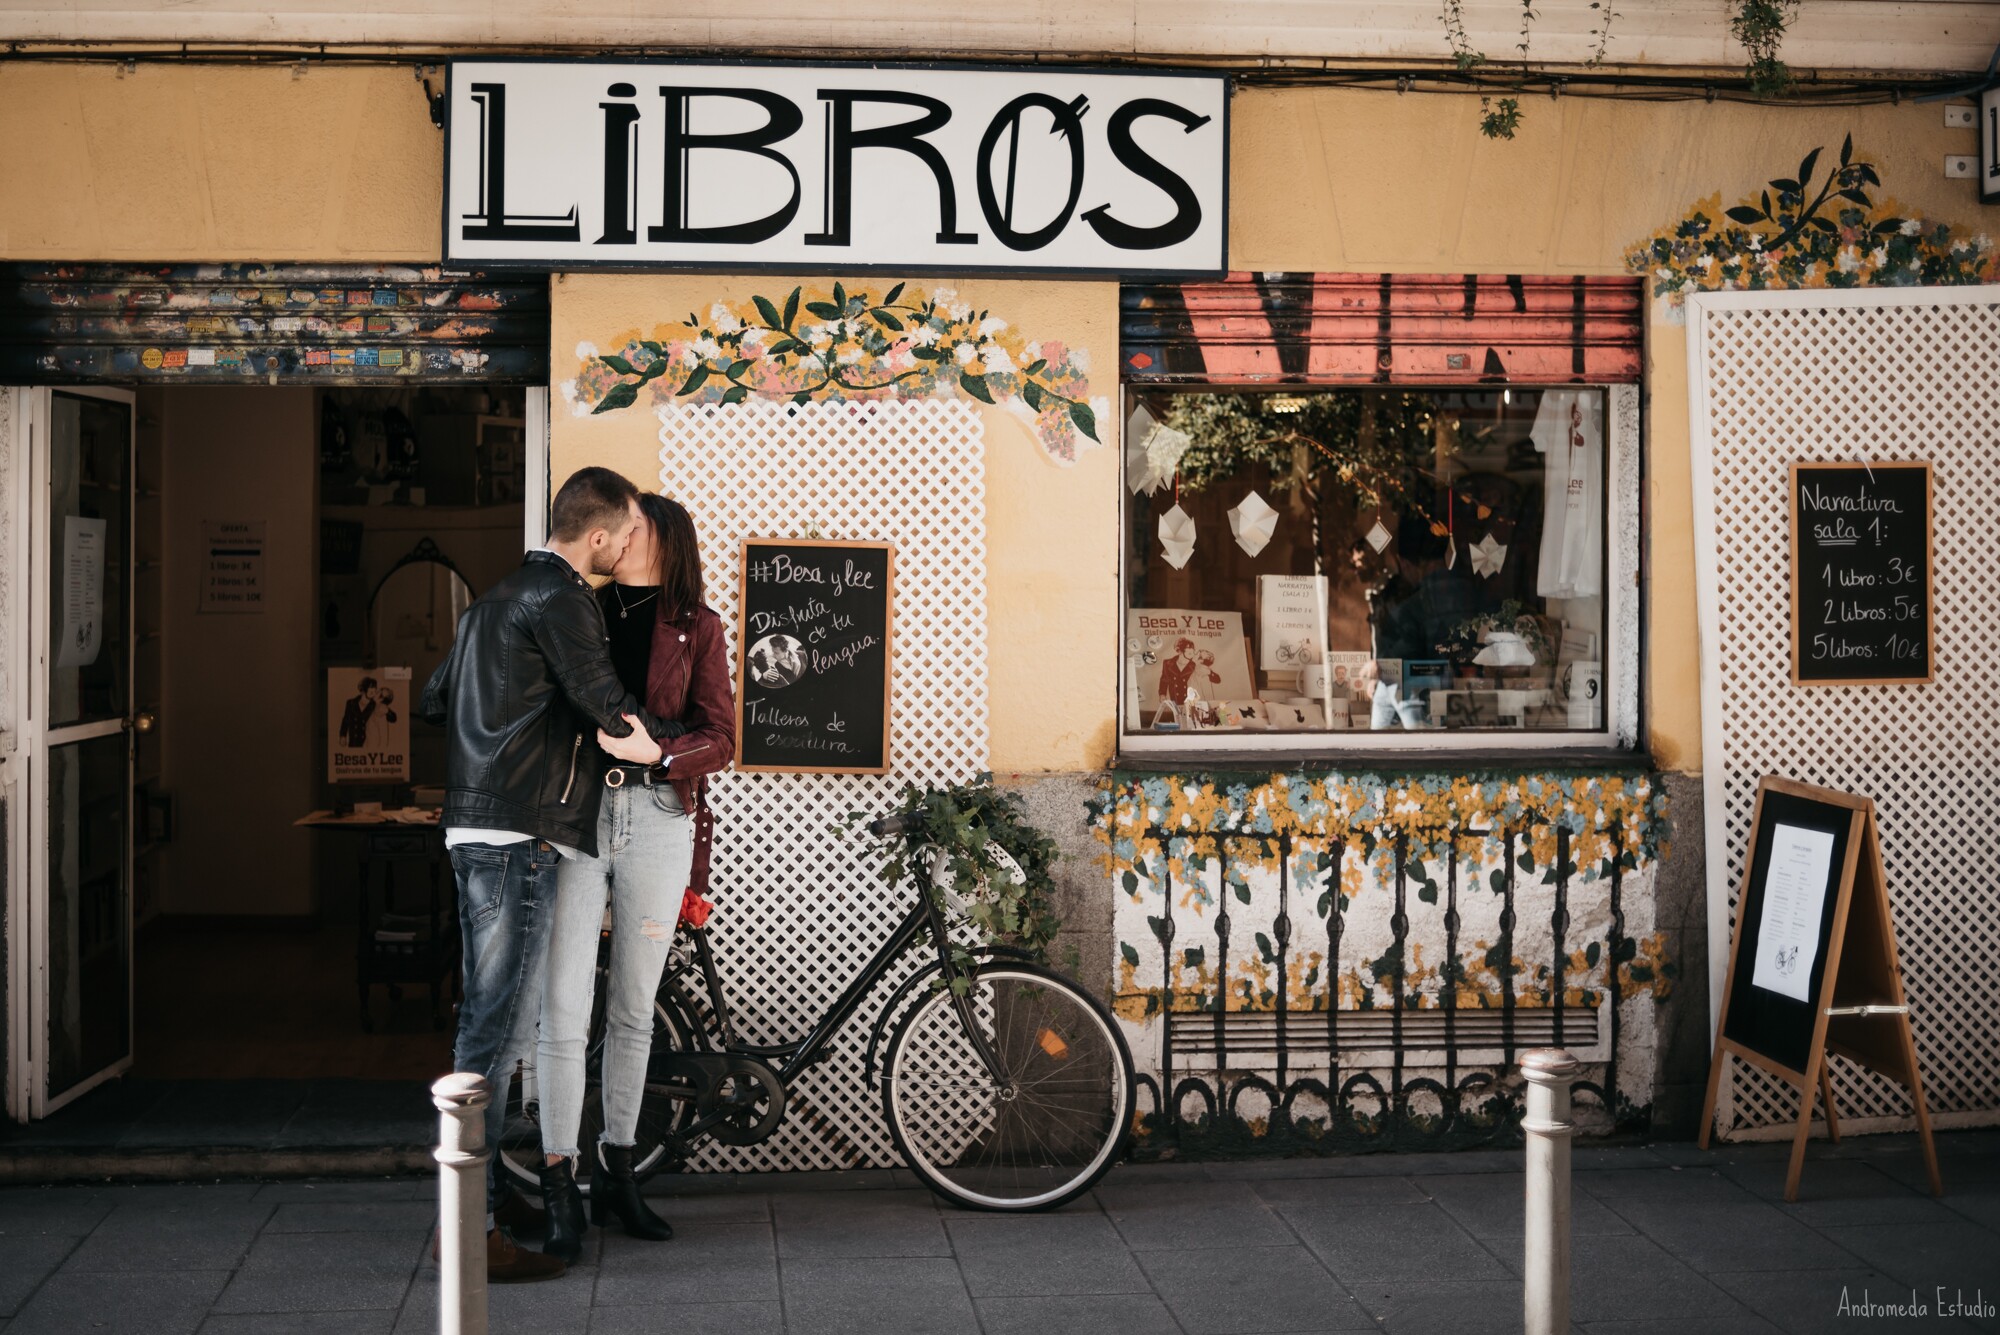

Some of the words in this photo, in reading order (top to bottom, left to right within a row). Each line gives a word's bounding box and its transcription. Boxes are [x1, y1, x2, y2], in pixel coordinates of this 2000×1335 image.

[1568, 479, 1583, 489] ee
[1801, 483, 1904, 513] Narrativa
[1813, 517, 1861, 540] sala
[748, 554, 826, 585] #Besa
[1822, 563, 1831, 587] 1
[1886, 557, 1917, 585] 3€
[749, 597, 831, 634] Disfruta
[1824, 599, 1837, 624] 2
[1841, 600, 1892, 622] libros:
[1895, 595, 1920, 622] 5€
[808, 625, 827, 643] de
[831, 613, 855, 631] tu
[1138, 616, 1178, 628] Besa
[1181, 615, 1193, 628] Y
[1197, 616, 1225, 630] Lee
[1188, 629, 1196, 637] tu
[1197, 630, 1222, 638] lengua
[1812, 633, 1828, 660] 5
[1830, 637, 1878, 658] libros:
[1885, 633, 1922, 660] 10€
[827, 711, 846, 732] de
[334, 753, 367, 766] Besa
[368, 753, 378, 765] Y
[380, 753, 403, 765] Lee
[335, 767, 363, 775] Disfruta
[380, 767, 402, 775] lengua
